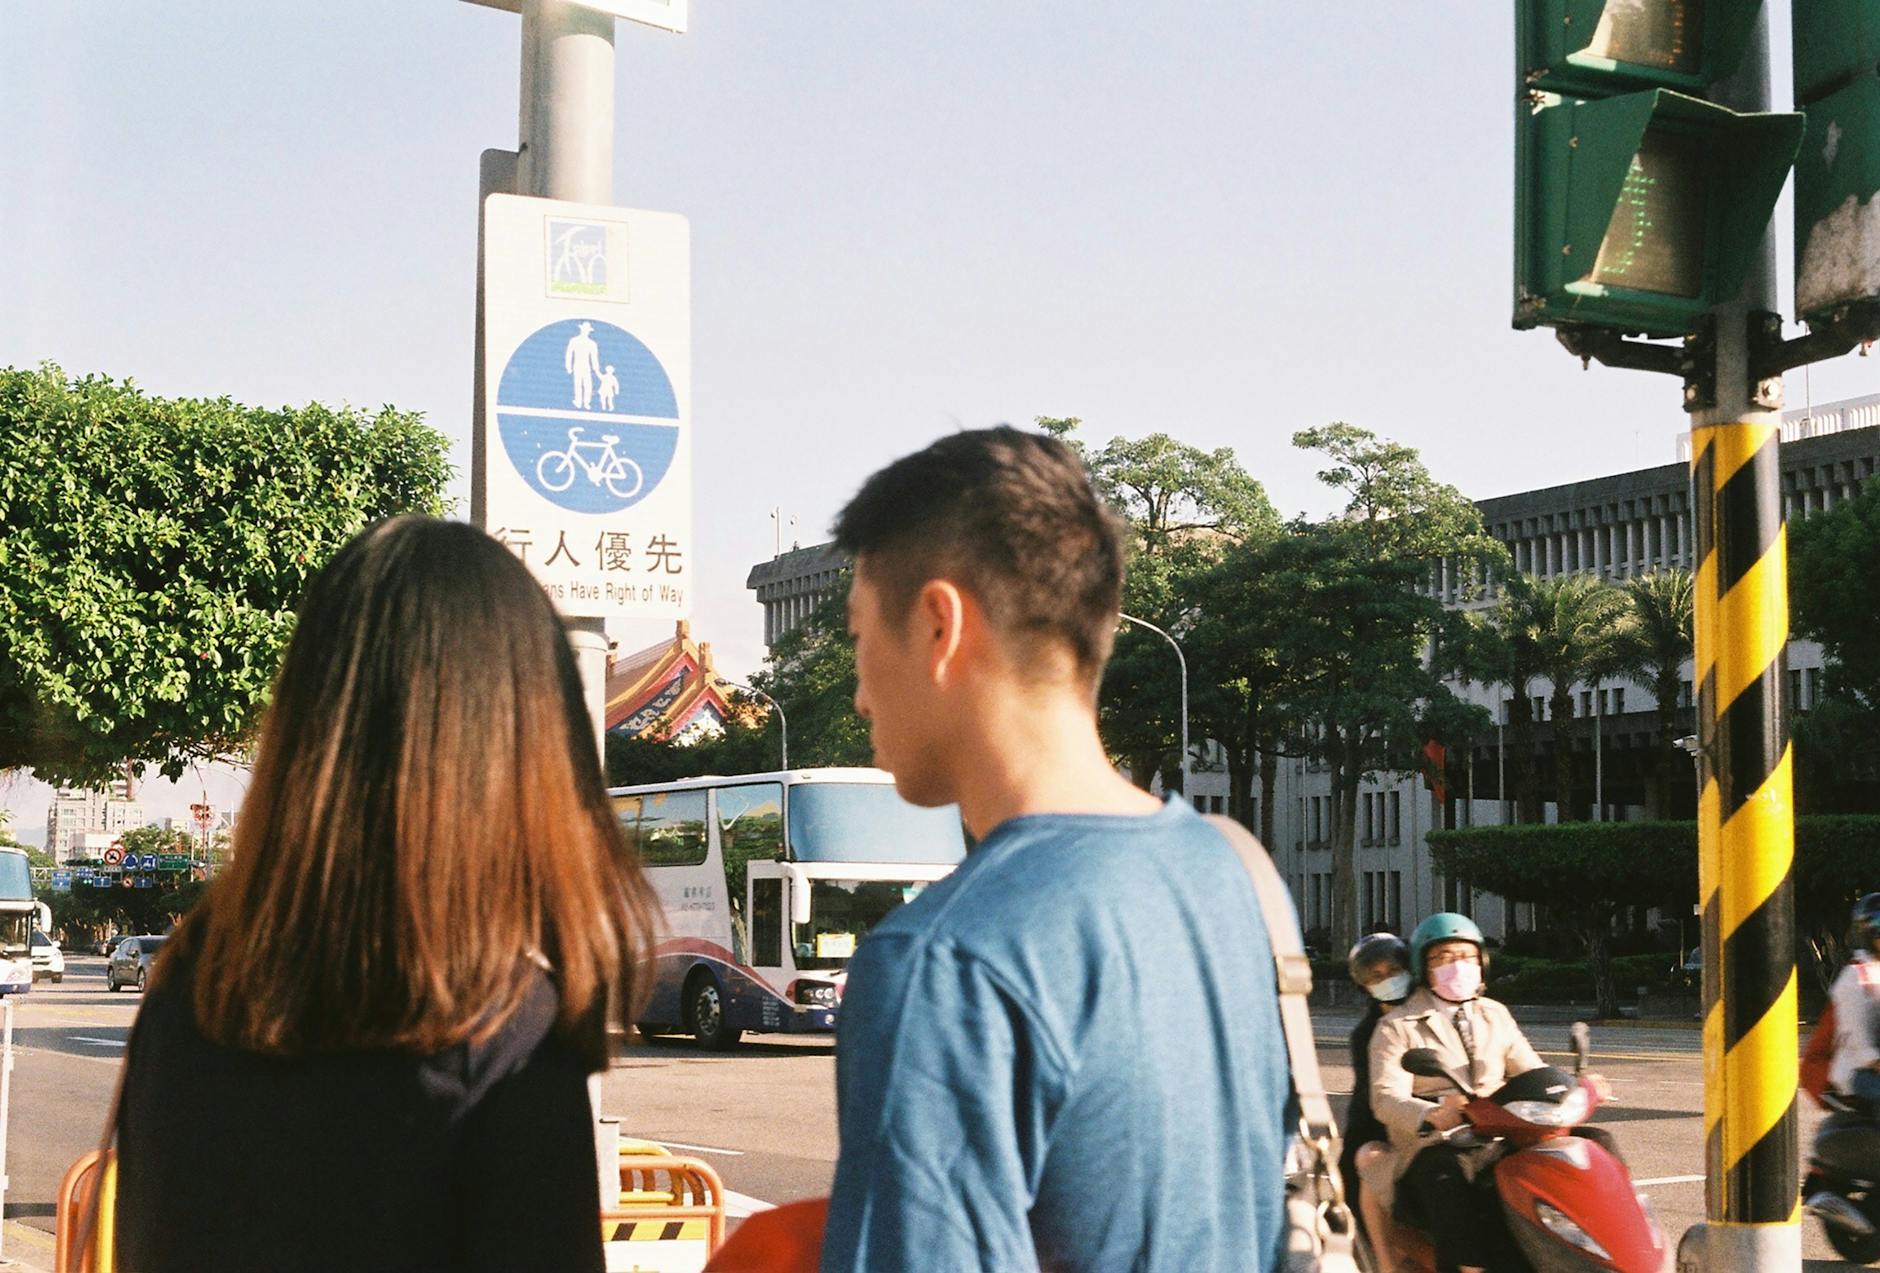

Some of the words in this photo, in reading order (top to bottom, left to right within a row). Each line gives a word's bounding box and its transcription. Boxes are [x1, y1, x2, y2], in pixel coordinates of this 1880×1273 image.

[571, 581, 600, 600] Have
[606, 582, 636, 606] Right
[642, 584, 655, 602] of
[660, 585, 684, 607] Way
